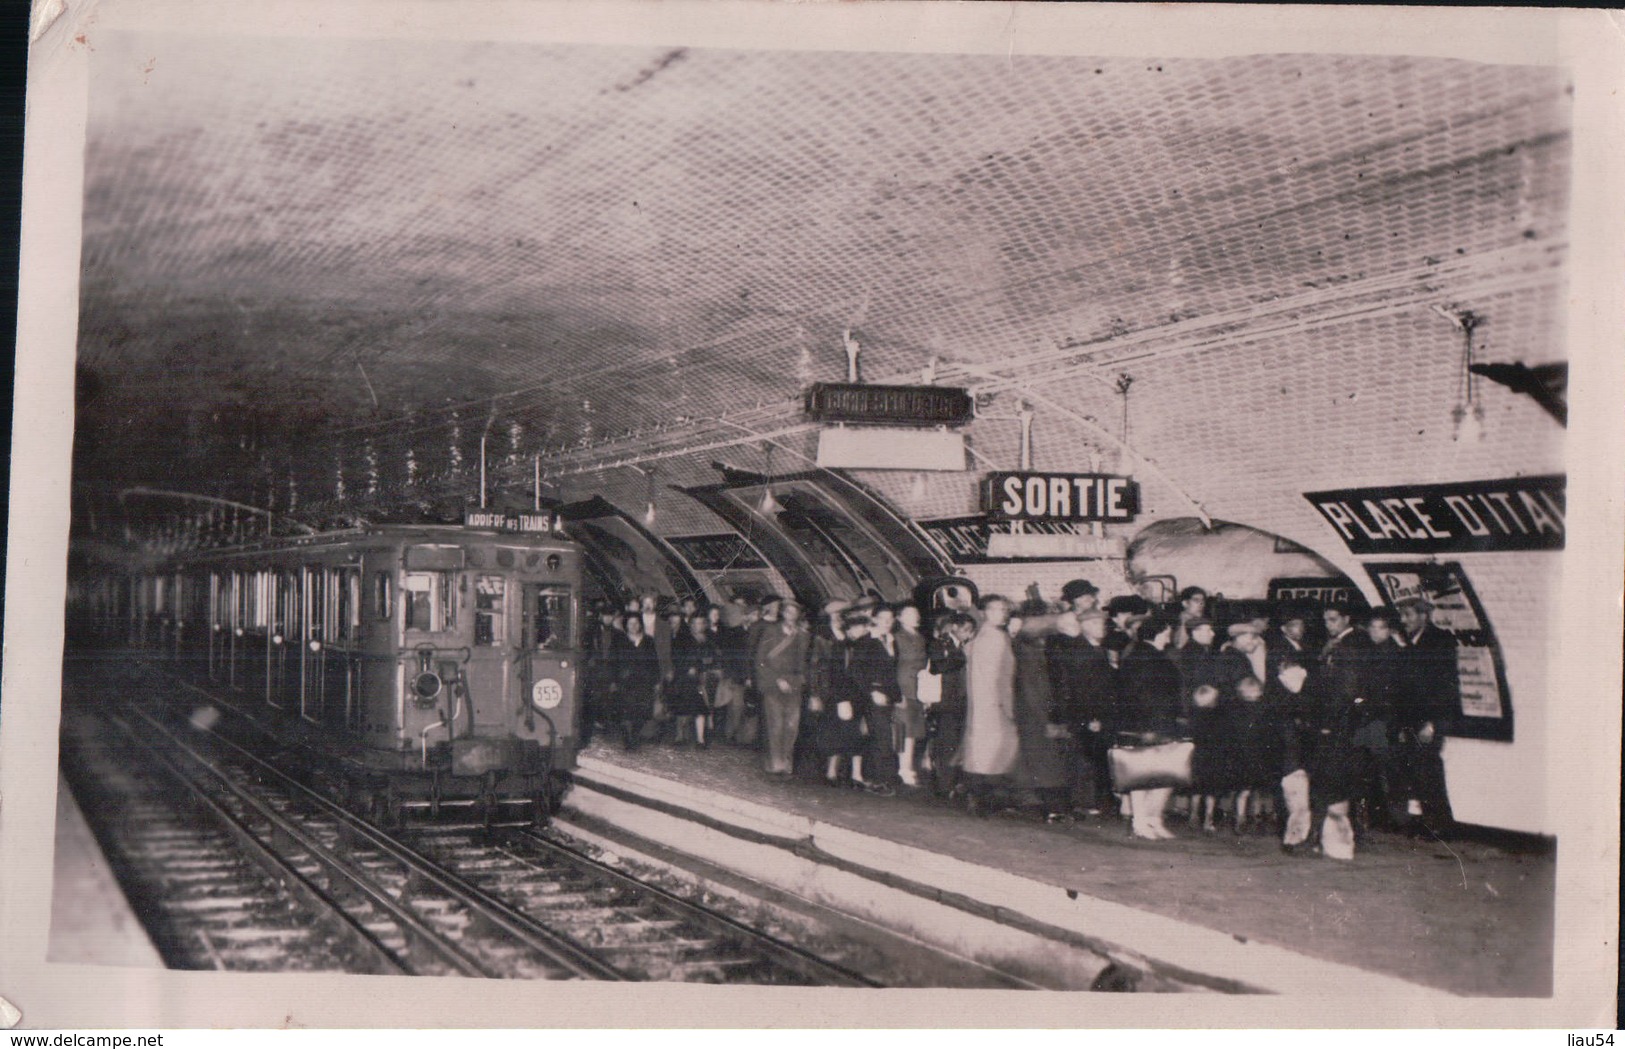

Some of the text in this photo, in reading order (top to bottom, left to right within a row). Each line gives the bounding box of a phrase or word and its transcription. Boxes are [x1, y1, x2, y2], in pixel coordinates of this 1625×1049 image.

[1002, 476, 1128, 517] SORTIE
[519, 515, 549, 532] TRAINS
[1318, 498, 1451, 540] PLACE
[535, 685, 560, 702] 355
